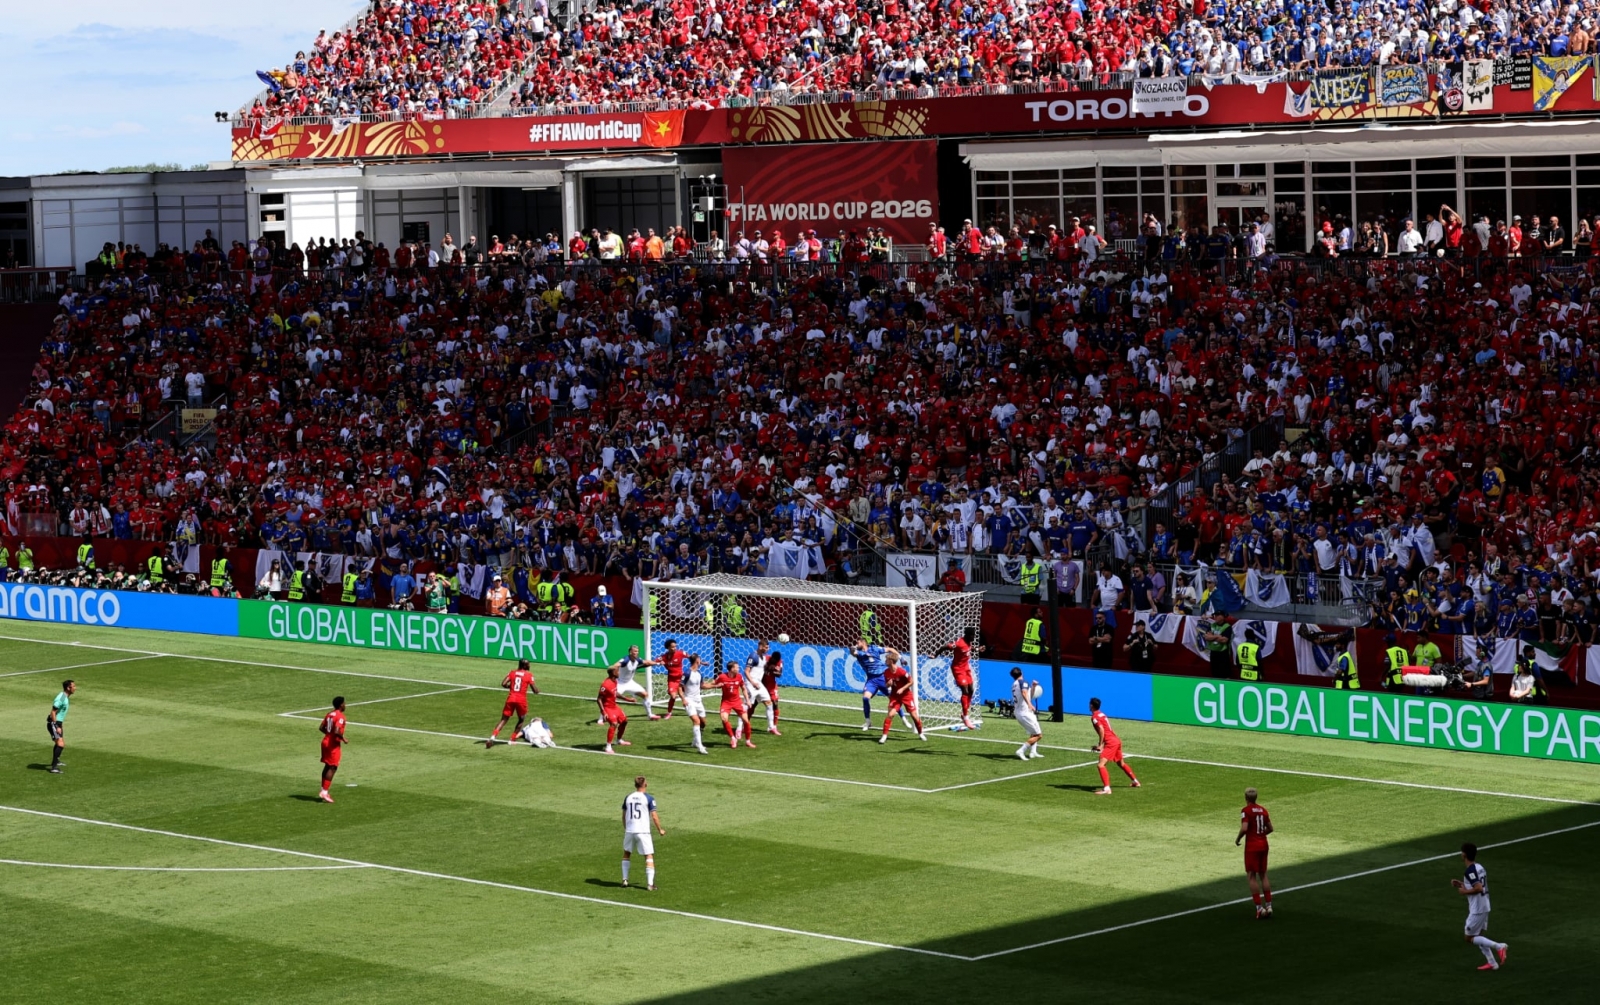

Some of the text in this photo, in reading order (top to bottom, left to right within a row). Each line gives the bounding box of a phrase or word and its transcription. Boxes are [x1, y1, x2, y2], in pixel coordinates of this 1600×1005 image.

[1141, 83, 1179, 94] KOZARAC
[1312, 74, 1363, 104] VITEZ
[1025, 94, 1209, 122] TOROO
[529, 119, 642, 143] #FIFAWorldCup
[728, 199, 933, 222] FIFA WORLD CUP 2026
[268, 604, 609, 667] GLOBAL ENERGY PARTNER
[514, 677, 522, 692] 8
[793, 646, 976, 701] arco
[1193, 681, 1600, 761] GLOBAL ENERGY PAR
[629, 802, 642, 820] 15
[1256, 814, 1265, 834] 11
